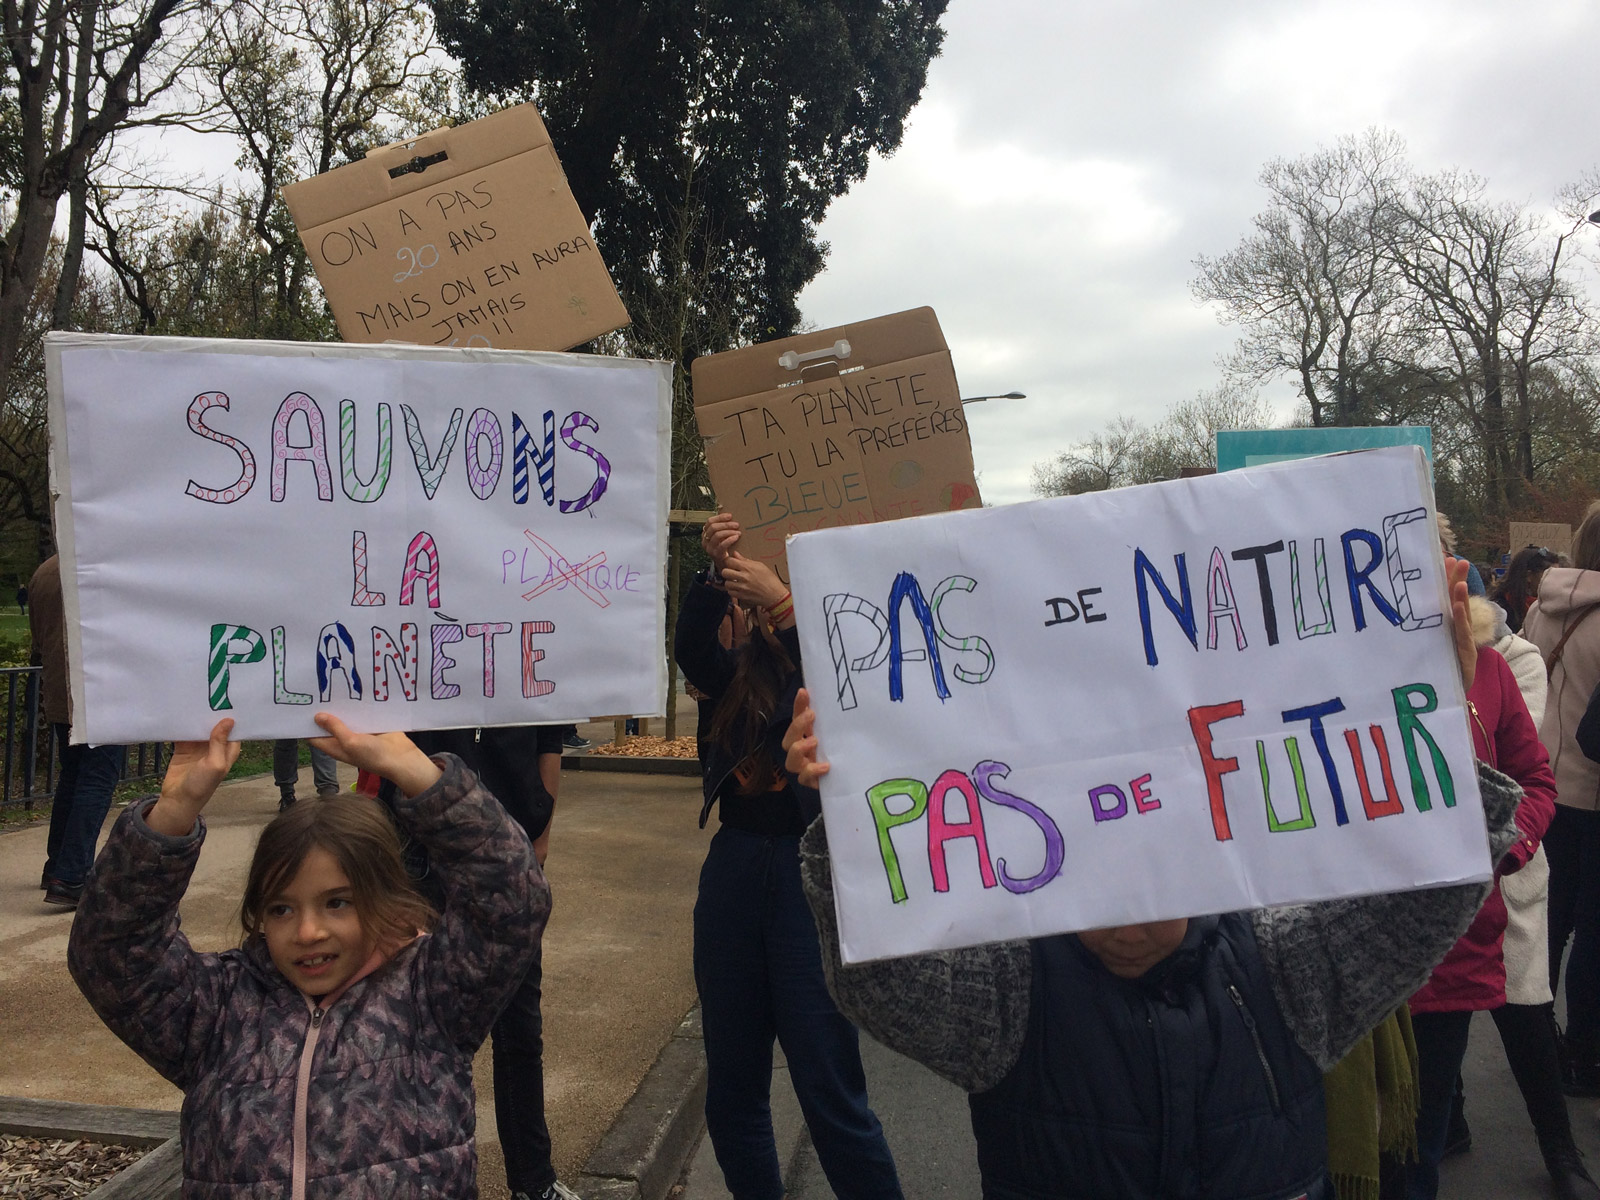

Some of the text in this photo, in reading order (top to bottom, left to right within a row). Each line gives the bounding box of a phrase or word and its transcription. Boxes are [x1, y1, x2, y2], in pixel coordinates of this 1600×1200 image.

[321, 180, 493, 266] ON A PAS
[393, 221, 498, 283] 20 ANS
[356, 235, 592, 335] MAIS ON EN AURA
[432, 293, 527, 345] JAMAIS
[724, 373, 941, 447] TA PLANÈTE,
[184, 391, 612, 517] SAUVONS
[745, 449, 798, 483] TU
[811, 437, 846, 468] LA
[744, 472, 868, 530] BLEUE
[351, 530, 441, 608] LA
[823, 507, 1443, 711] PAS DE NATURE
[207, 610, 556, 711] PLANÈTE
[865, 683, 1457, 904] PAS DE FUTUR
